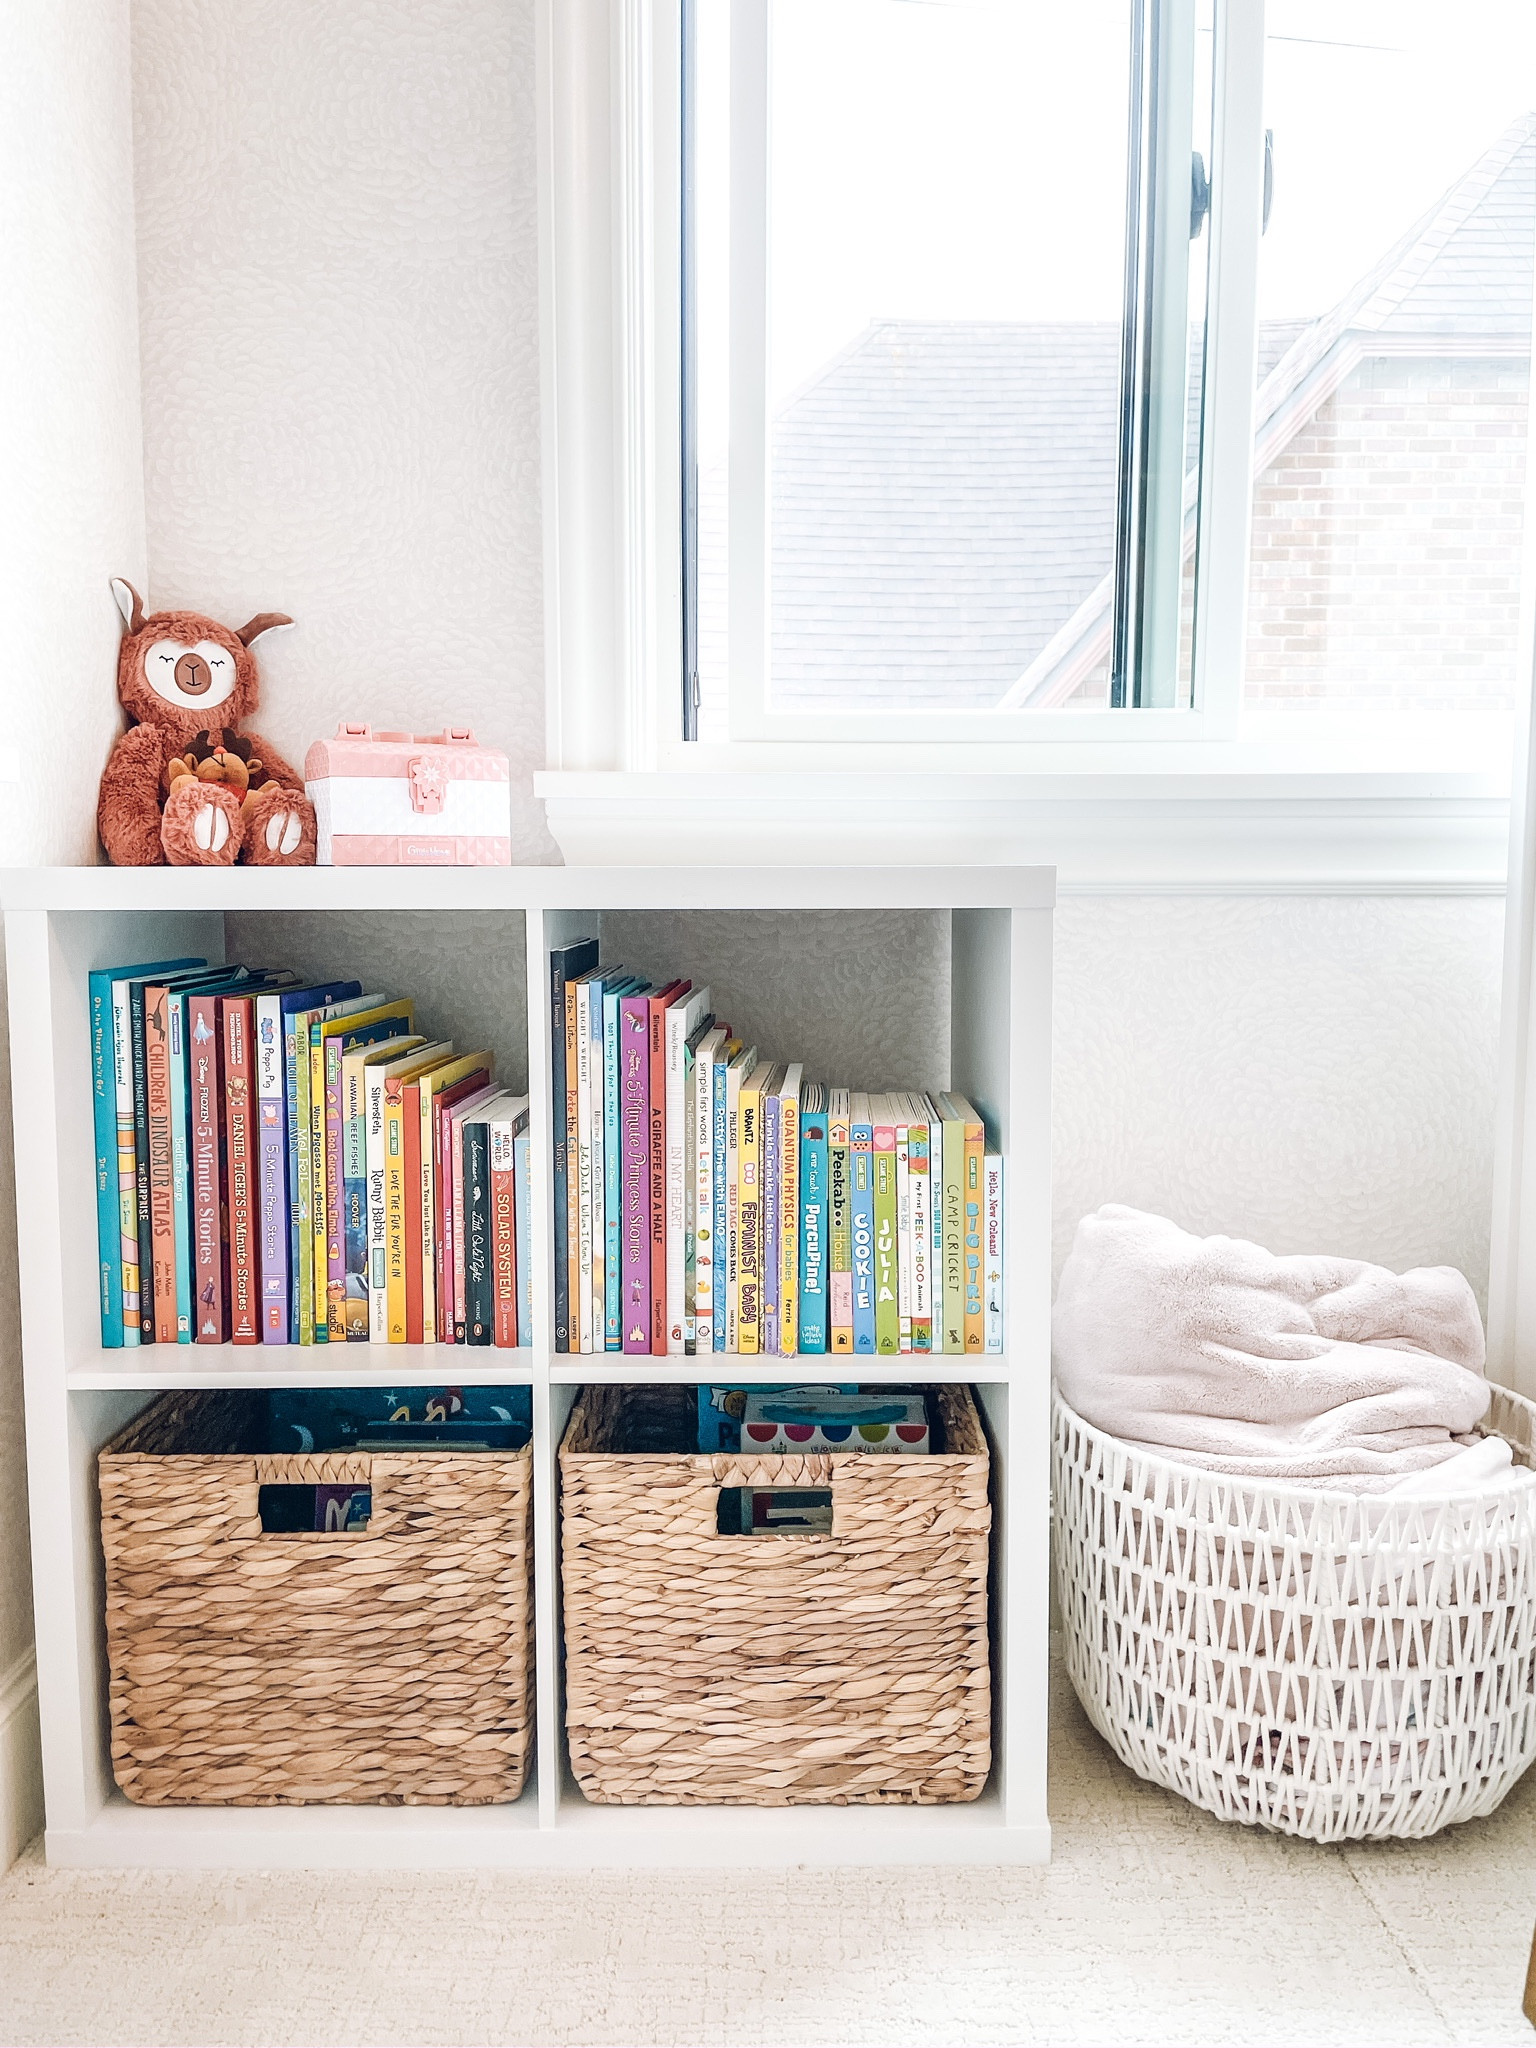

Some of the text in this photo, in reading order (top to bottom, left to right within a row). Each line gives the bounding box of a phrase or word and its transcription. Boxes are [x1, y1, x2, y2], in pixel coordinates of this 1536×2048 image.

[95, 1028, 103, 1053] Places
[567, 1025, 575, 1050] Litwin
[652, 1014, 660, 1053] Silverstein
[262, 1047, 274, 1089] Peppa Pig
[328, 1047, 337, 1084] SESAME STREET
[96, 1079, 104, 1096] Go!
[568, 1090, 577, 1112] Pete
[350, 1075, 360, 1176] HAWAIIAN REEF FISHES
[371, 1086, 383, 1136] Silverstein
[568, 1116, 576, 1132] the
[714, 1108, 725, 1142] Potty
[729, 1111, 737, 1149] PHLEGER
[745, 1108, 754, 1145] BRANTZ
[151, 1115, 170, 1187] DINOSAUR
[297, 1127, 309, 1183] Mel Fell
[313, 1132, 321, 1168] Pigasso
[391, 1138, 399, 1156] STREET
[556, 1142, 565, 1172] Maybe
[568, 1136, 577, 1153] Cat
[699, 1062, 709, 1214] simple first words Let's talk
[716, 1144, 725, 1172] Time
[174, 1137, 185, 1202] Bedtime Songs
[196, 1056, 216, 1264] Disney FROZEN 5-Minute Stories
[624, 1080, 647, 1264] 5-Minute Princess Stories
[652, 1108, 662, 1244] A GIRAFFE AND A HALF
[766, 1113, 775, 1245] Twinkle Twinkle Little Star
[811, 1152, 819, 1168] NEVER
[139, 1177, 148, 1220] SURPRISE
[264, 1144, 279, 1259] 5-Minute Peppa Stories
[327, 1129, 340, 1238] Boo! Guess Who, Elmo!
[671, 1146, 682, 1229] IN MY HEART
[716, 1175, 725, 1201] with
[729, 1184, 737, 1206] RED
[785, 1109, 795, 1281] QUANTUM PHYSICS for babies
[809, 1169, 820, 1195] touch
[915, 1181, 922, 1191] My
[154, 1190, 171, 1236] ATLAS
[233, 1114, 251, 1310] DANIEL TIGER'S 5-Minute Stories
[351, 1193, 360, 1229] HOOVER
[371, 1168, 385, 1244] Runny Babbit
[390, 1169, 402, 1278] LOVE THE FUR YOU'RE IN
[471, 1210, 484, 1232] Little
[716, 1204, 726, 1236] ELMO
[832, 1150, 846, 1270] Peekaboo House
[988, 1171, 999, 1256] Hello, New Orleans!
[497, 1194, 512, 1299] SOLAR SYSTEM
[741, 1202, 757, 1278] FEMINIST
[915, 1212, 925, 1282] PEEK-A-BOO
[947, 1184, 959, 1292] CAMP CRICKET
[966, 1203, 982, 1315] BIG BIRD
[469, 1256, 485, 1282] Night
[854, 1213, 872, 1309] COOKIE
[878, 1219, 894, 1303] JULIA
[329, 1304, 340, 1332] studio
[740, 1284, 757, 1324] BABY
[785, 1298, 793, 1324] Ferrie
